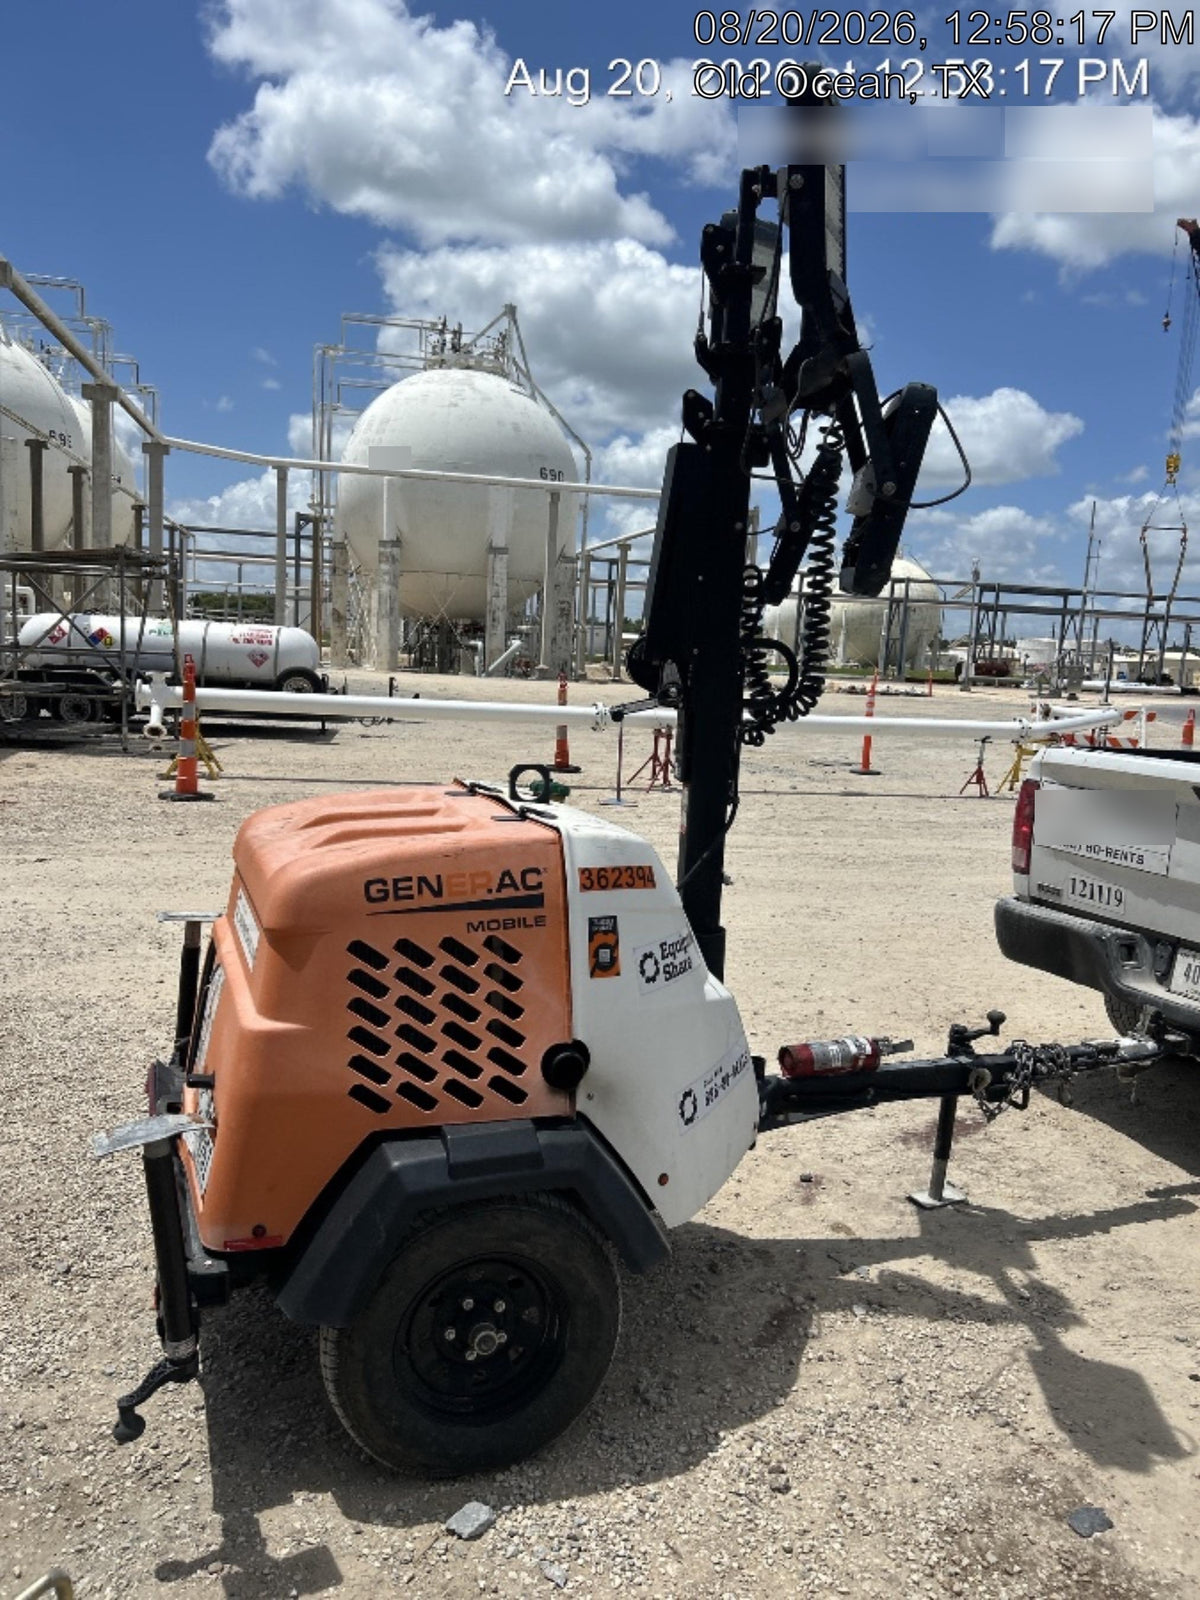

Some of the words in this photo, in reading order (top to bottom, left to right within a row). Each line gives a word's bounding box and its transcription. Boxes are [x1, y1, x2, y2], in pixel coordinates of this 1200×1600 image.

[540, 467, 564, 482] 690
[363, 867, 544, 904] GENERAC
[580, 866, 657, 890] 362394
[466, 915, 548, 934] MOBILE
